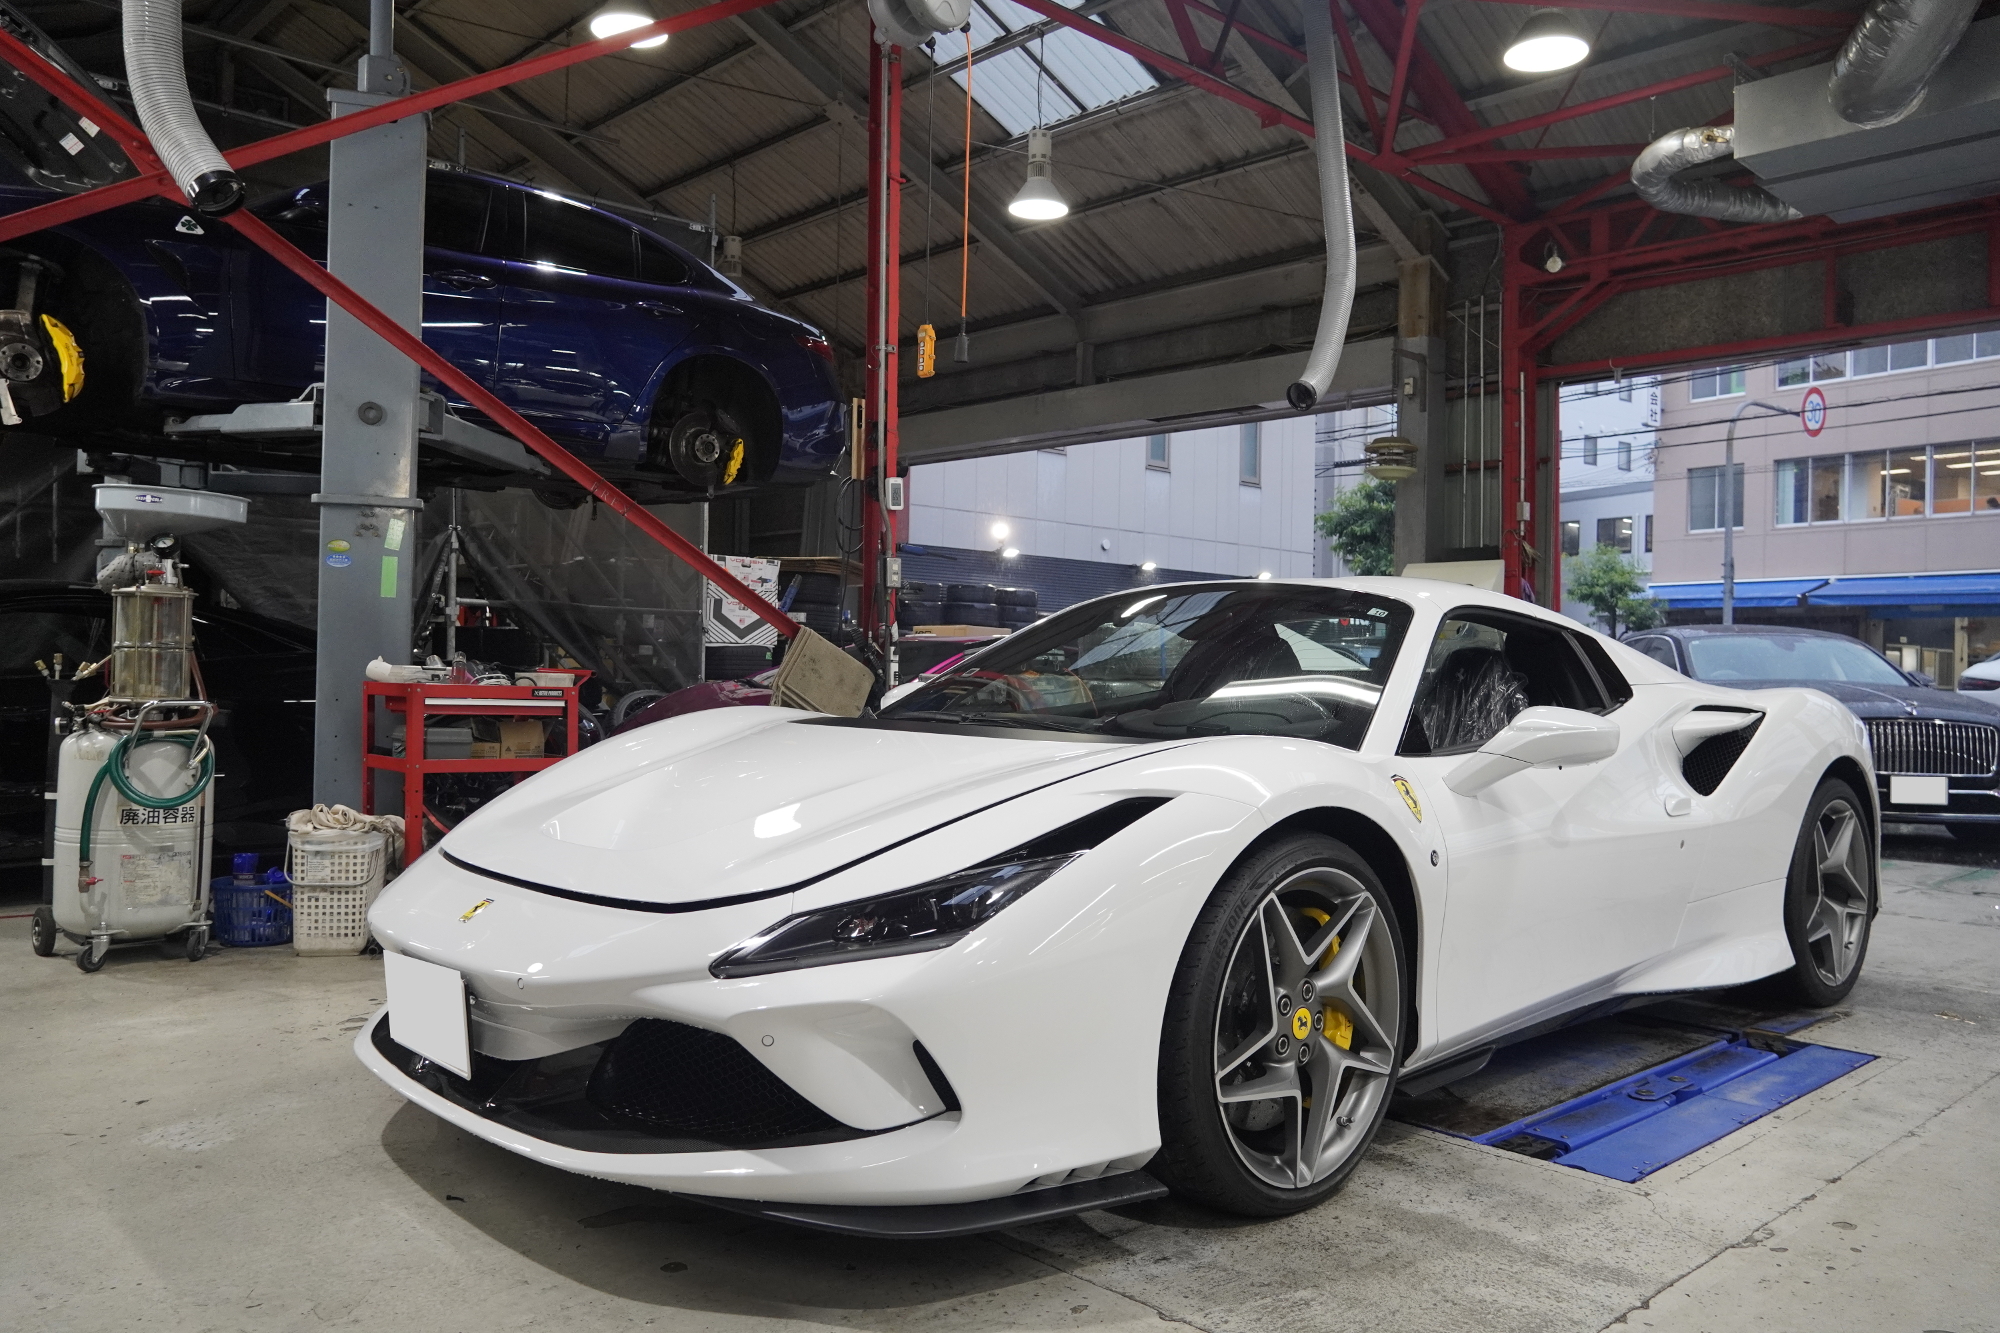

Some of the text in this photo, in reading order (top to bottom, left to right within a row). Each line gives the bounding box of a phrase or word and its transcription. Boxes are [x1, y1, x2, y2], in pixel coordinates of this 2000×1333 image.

[1807, 400, 1822, 424] 30
[120, 806, 195, 825] 廃油容器
